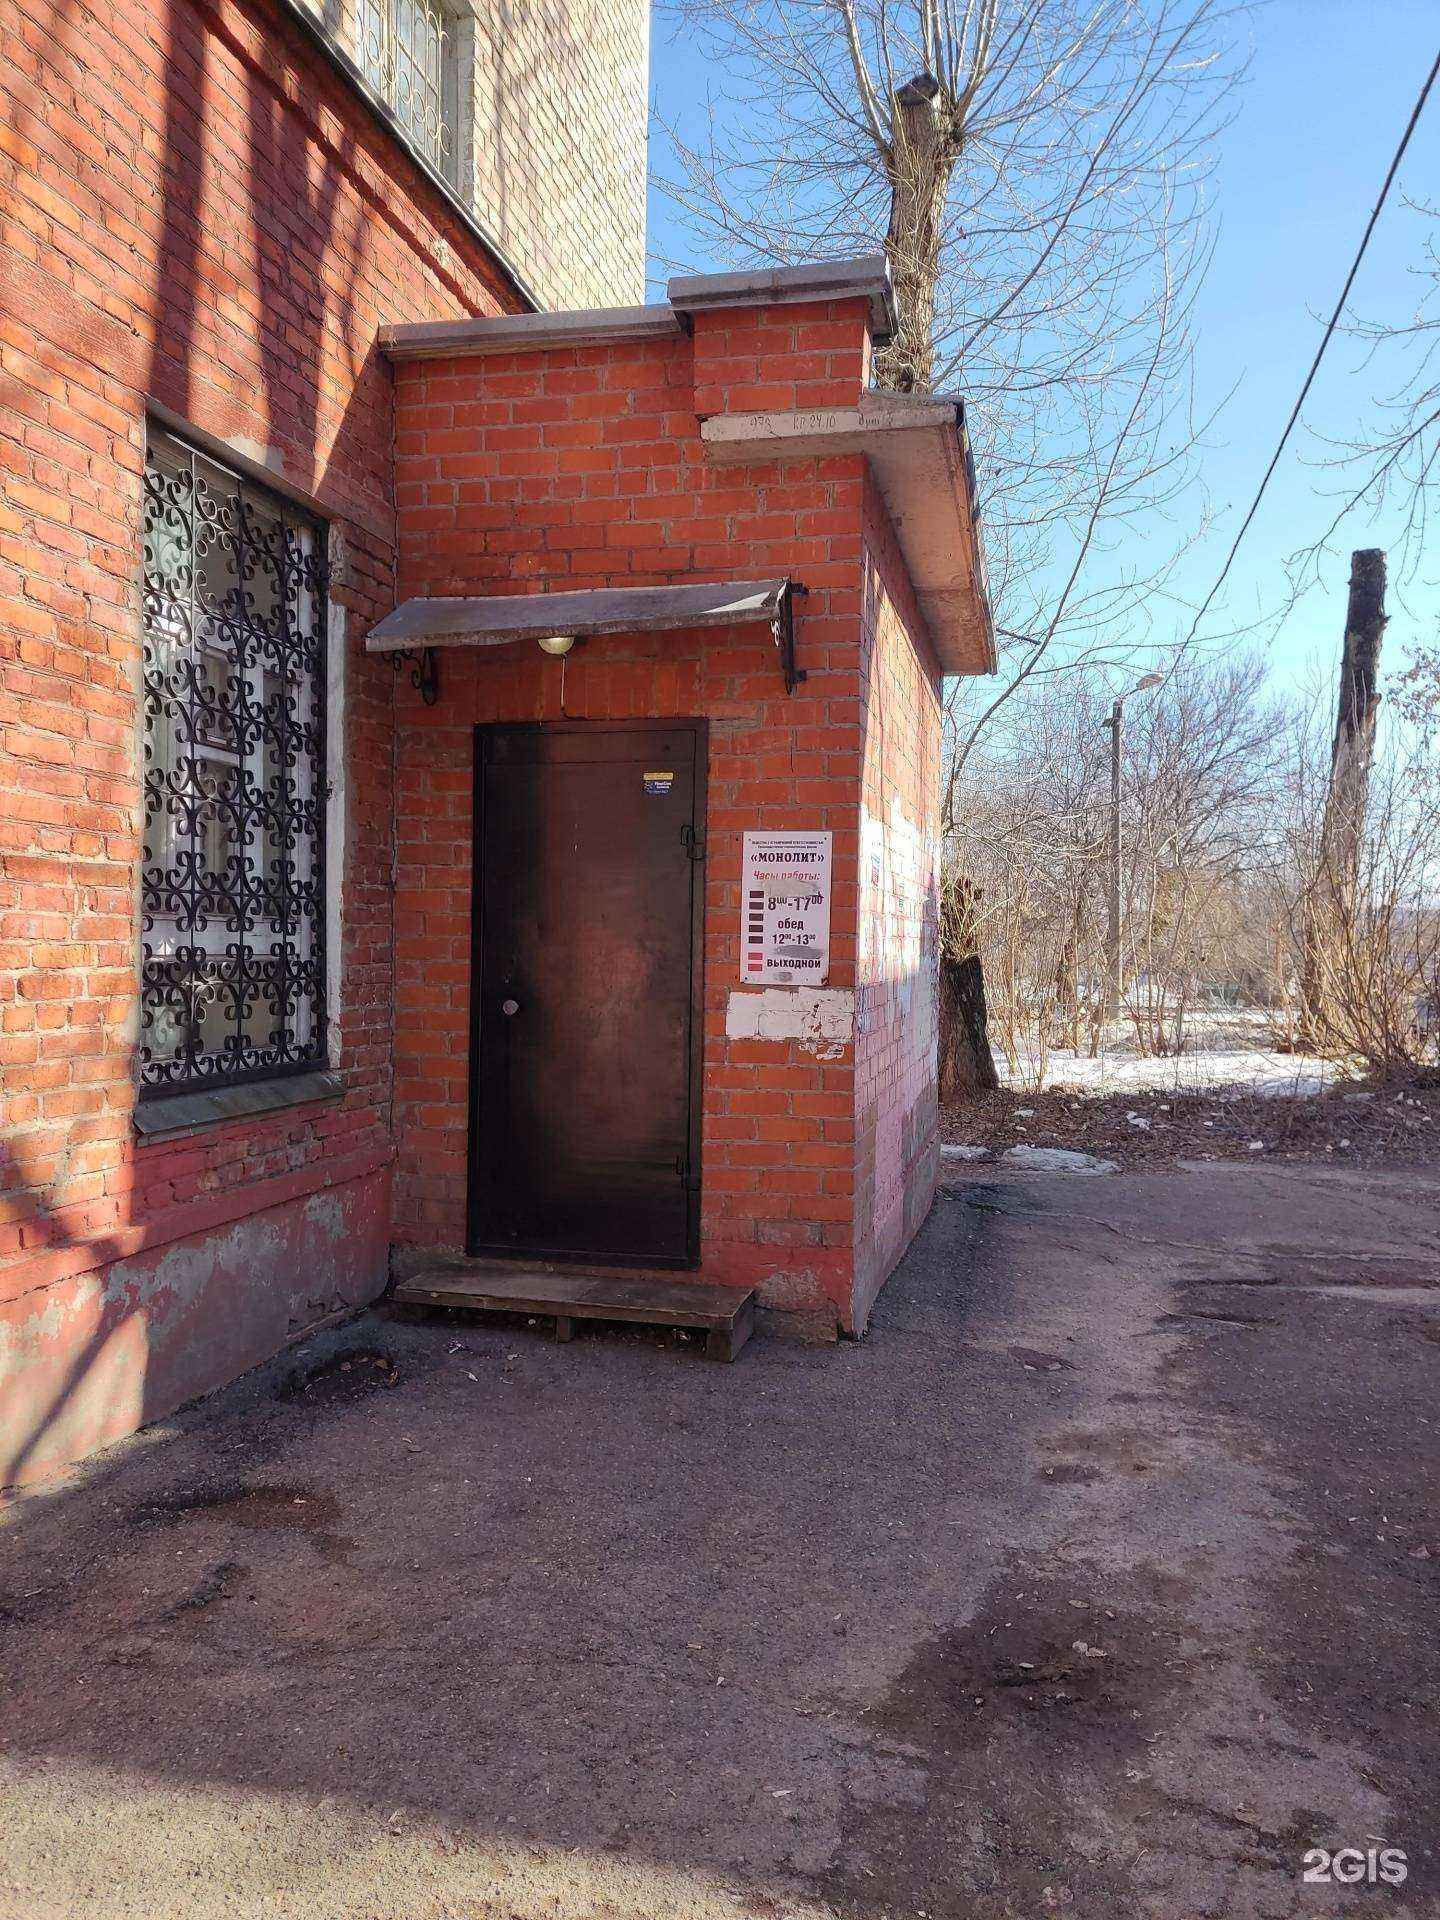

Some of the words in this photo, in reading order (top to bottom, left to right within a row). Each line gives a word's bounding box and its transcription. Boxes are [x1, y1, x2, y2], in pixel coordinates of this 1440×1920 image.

[750, 852, 825, 863] «МОНОЛИТ»
[753, 871, 779, 881] Часы
[781, 871, 821, 881] работы:
[777, 917, 804, 930] обед
